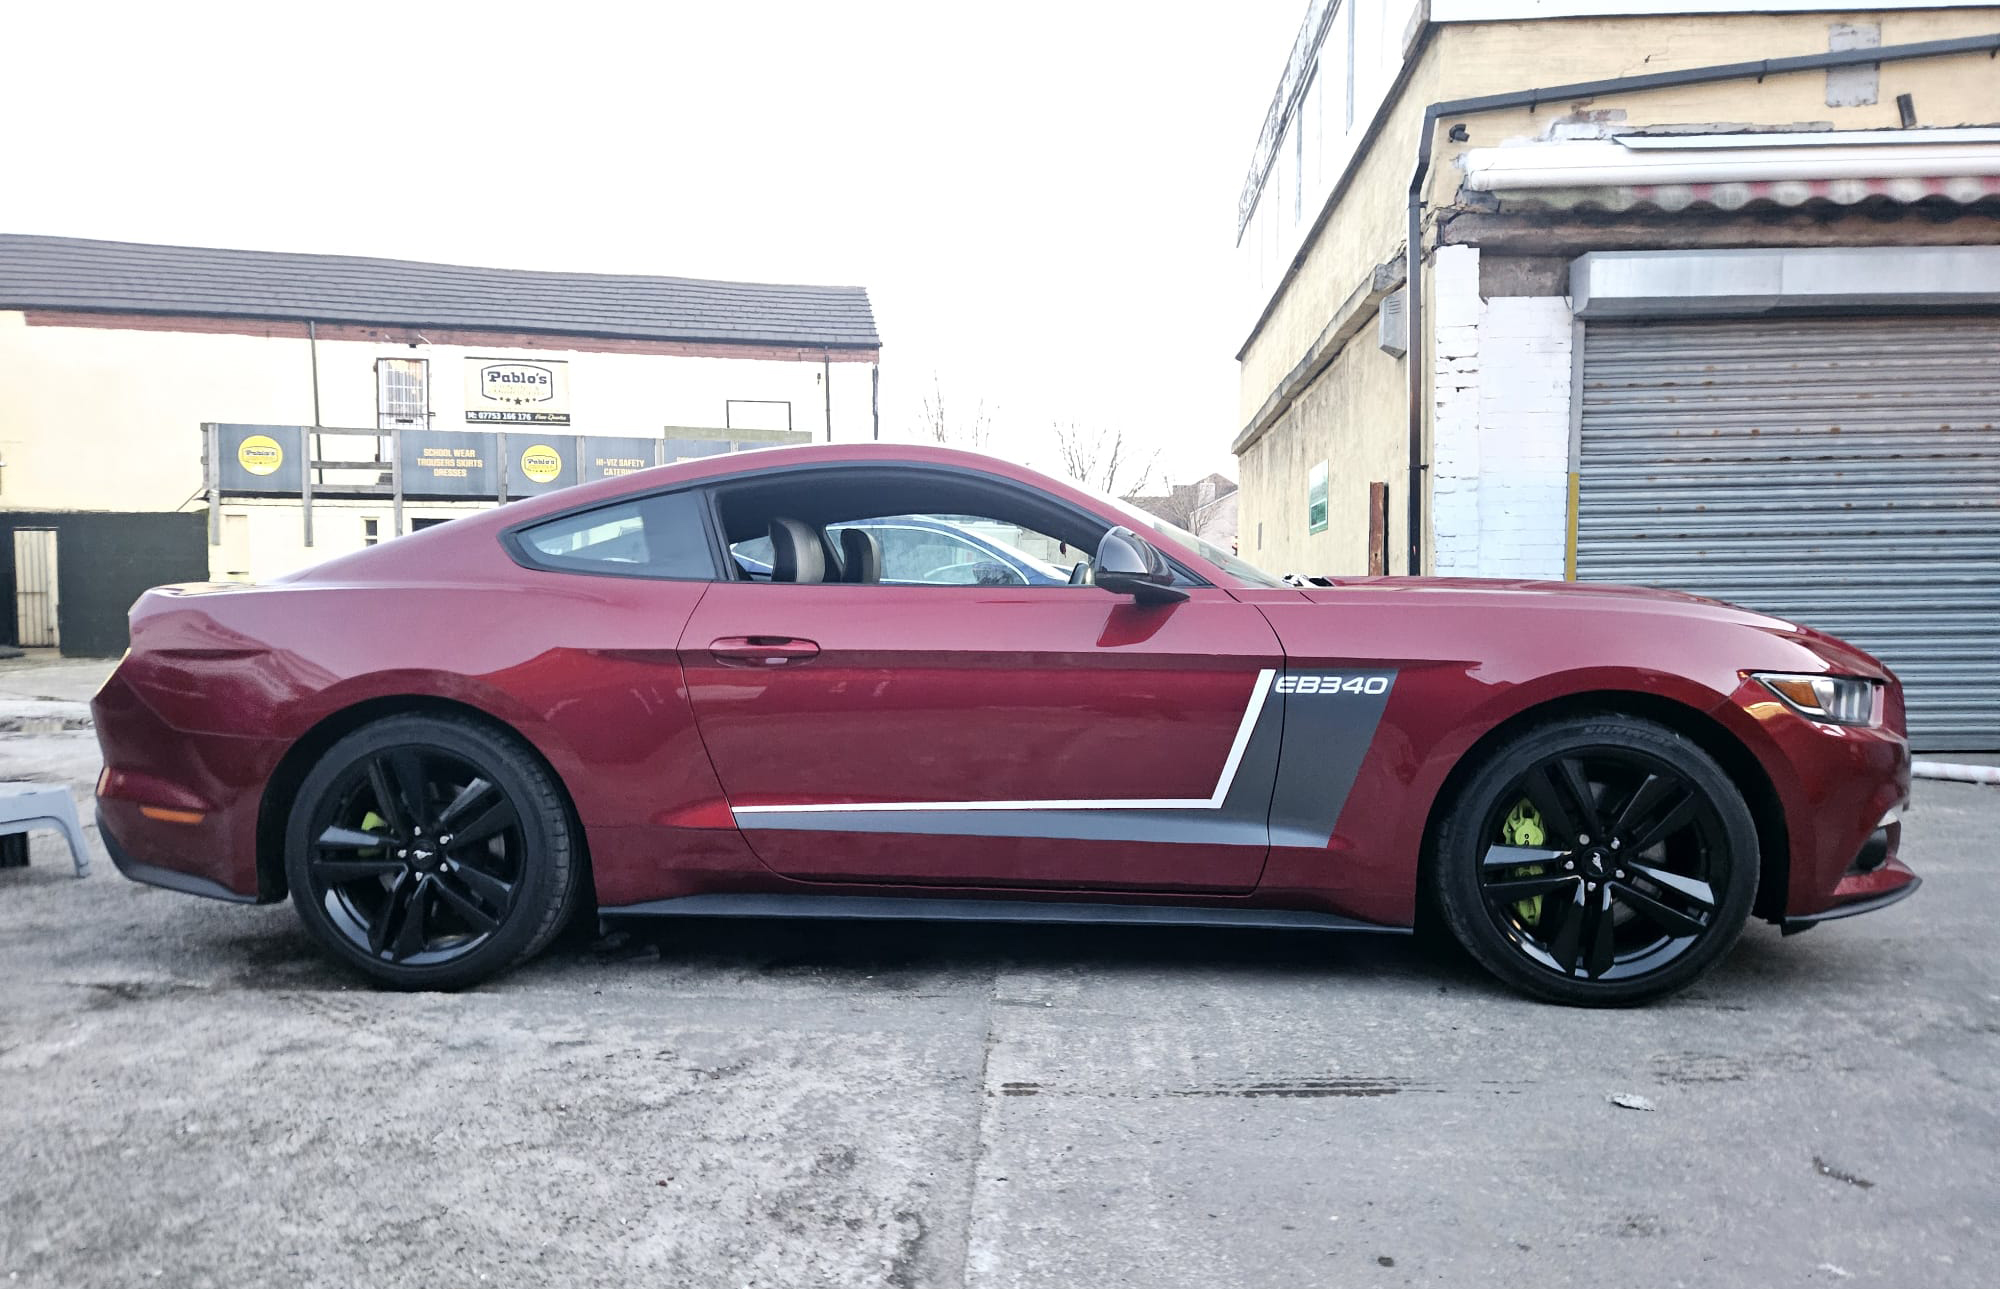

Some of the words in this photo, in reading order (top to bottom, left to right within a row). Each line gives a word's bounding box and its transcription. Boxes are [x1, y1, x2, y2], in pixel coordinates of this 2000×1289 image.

[487, 371, 547, 384] Pablo's
[423, 448, 452, 457] SCHOOL
[453, 449, 476, 458] WEAR
[417, 457, 455, 467] TROUSERS
[456, 459, 483, 468] SKIRTS
[619, 459, 644, 467] SAFETY
[433, 468, 467, 477] DRESSES
[1275, 676, 1388, 694] EB340
